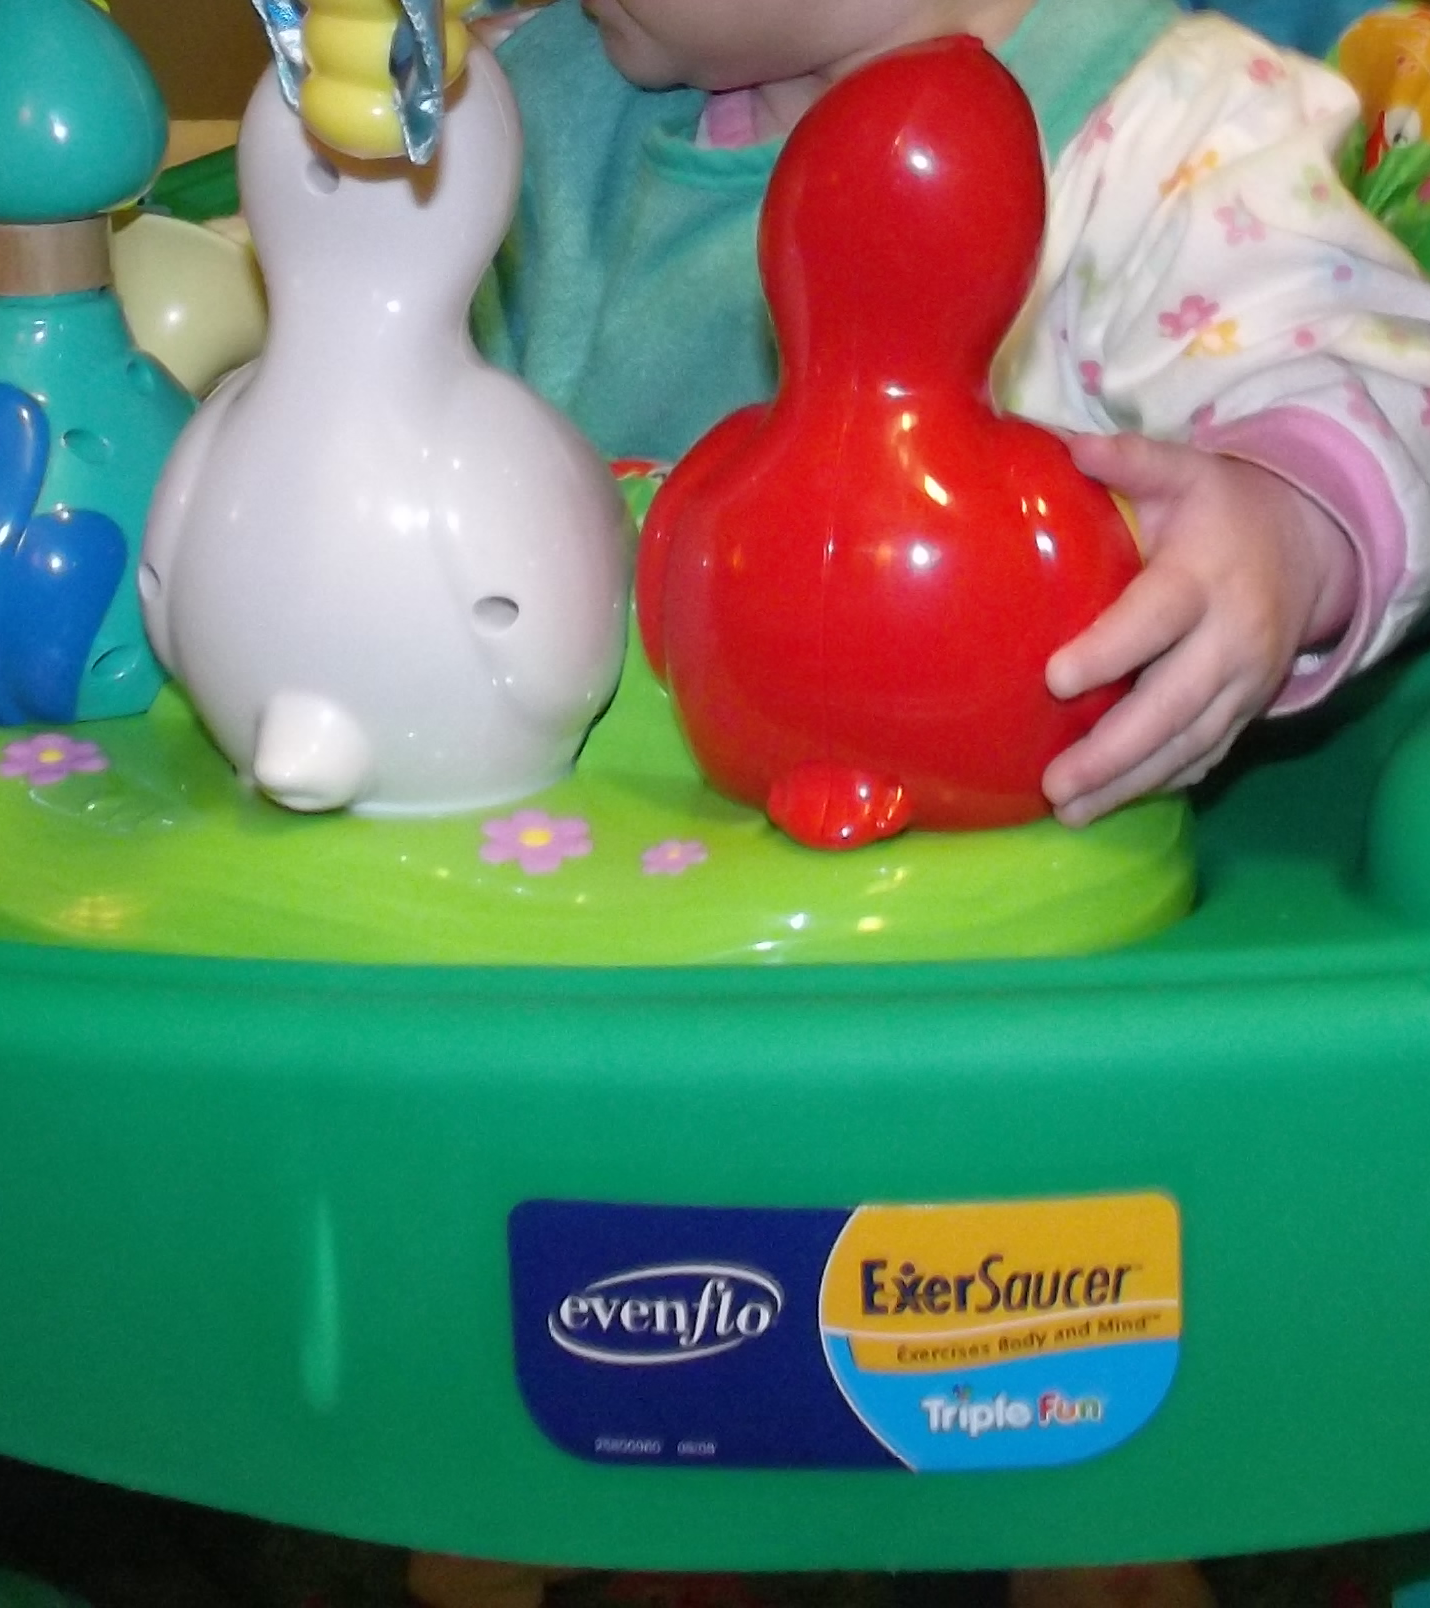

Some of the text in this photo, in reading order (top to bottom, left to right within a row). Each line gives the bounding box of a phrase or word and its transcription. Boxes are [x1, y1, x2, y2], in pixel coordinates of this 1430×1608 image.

[860, 1252, 1133, 1316] ExerSaucer
[560, 1279, 770, 1347] evenflo
[896, 1344, 991, 1365] Exercises
[998, 1330, 1047, 1352] Body
[1054, 1321, 1091, 1341] and
[922, 1390, 1102, 1438] Triple Fun
